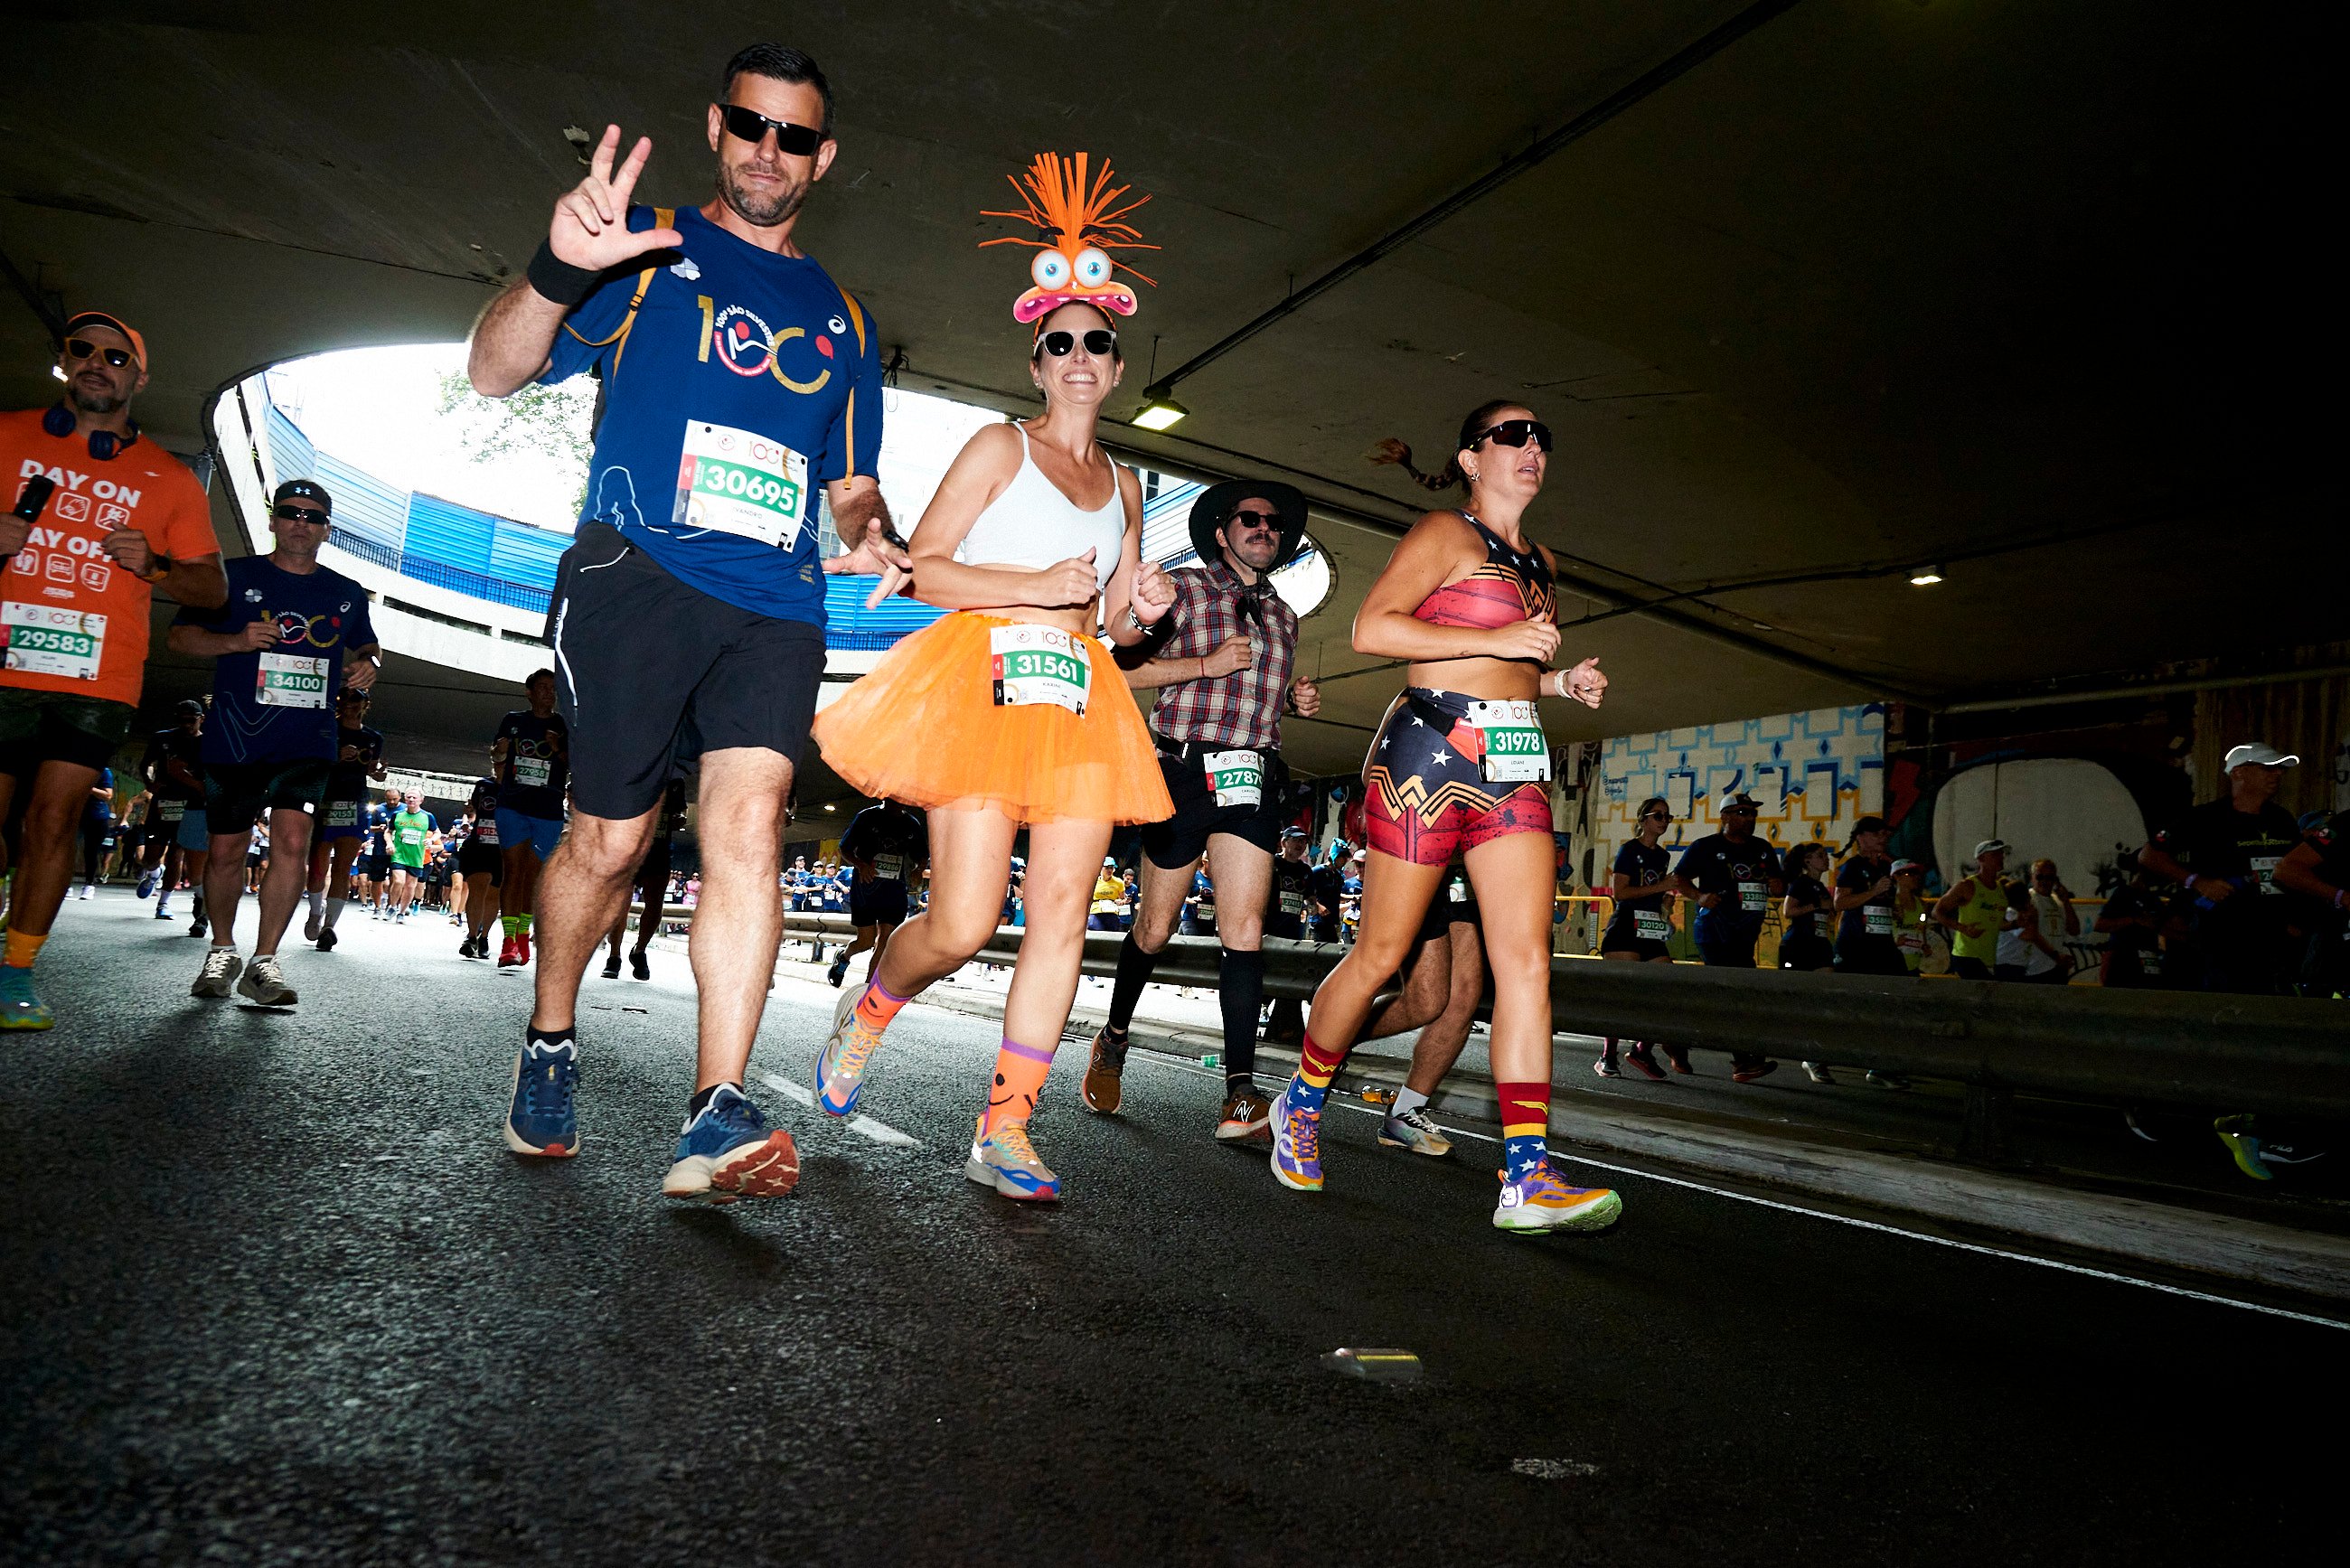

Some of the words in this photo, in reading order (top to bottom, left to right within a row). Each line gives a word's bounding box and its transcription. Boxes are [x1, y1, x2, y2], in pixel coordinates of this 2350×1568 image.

[727, 305, 745, 316] SÃO
[746, 309, 776, 347] SILVESTRE
[19, 459, 90, 491] DAY
[92, 480, 142, 509] ON
[705, 465, 794, 512] 30695
[18, 630, 89, 654] 29583
[1017, 654, 1077, 682] 31561
[273, 674, 320, 690] 34100
[1495, 731, 1540, 752] 31978
[519, 767, 545, 777] 27958
[327, 810, 352, 818] 29153
[1640, 921, 1665, 930] 30120
